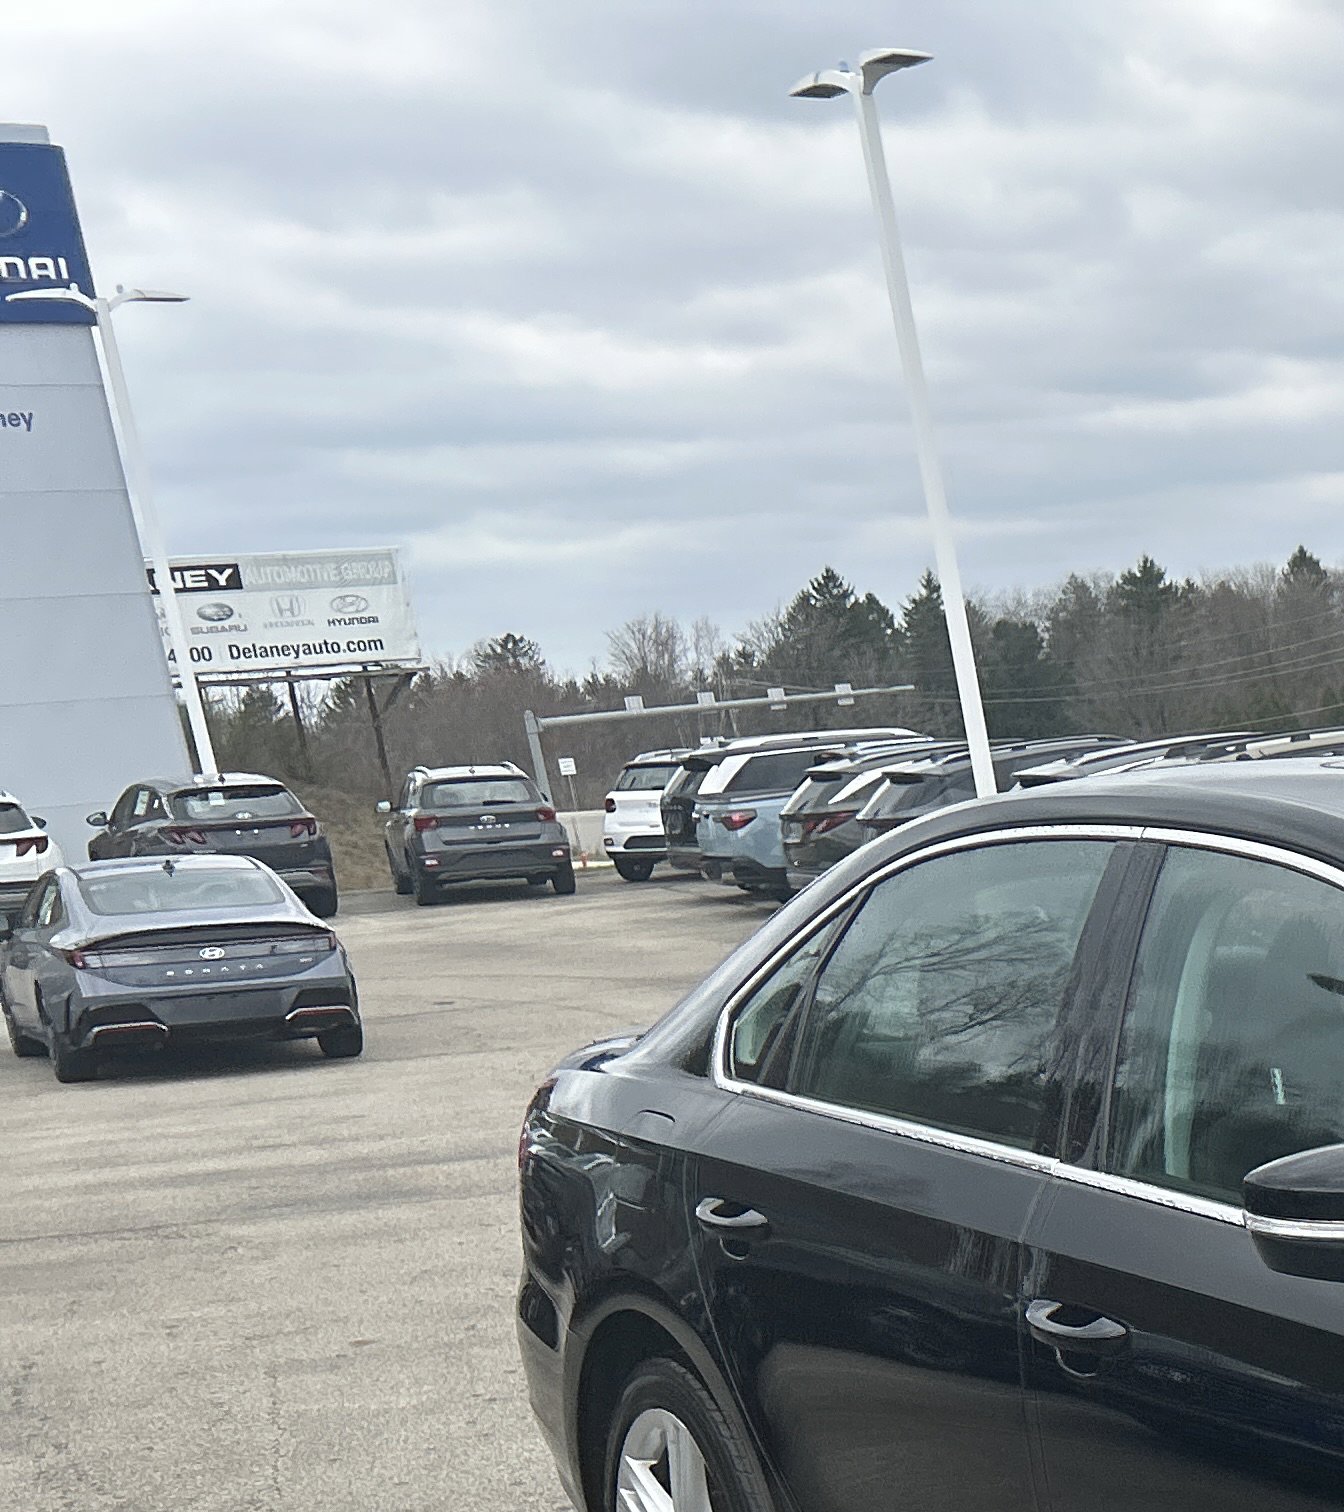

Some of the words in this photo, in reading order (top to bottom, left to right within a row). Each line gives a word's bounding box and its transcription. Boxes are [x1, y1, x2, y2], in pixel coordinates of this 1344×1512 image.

[327, 616, 379, 627] HYUNDAI
[190, 624, 248, 635] SUBARU
[228, 638, 385, 661] Delaneyauto.com
